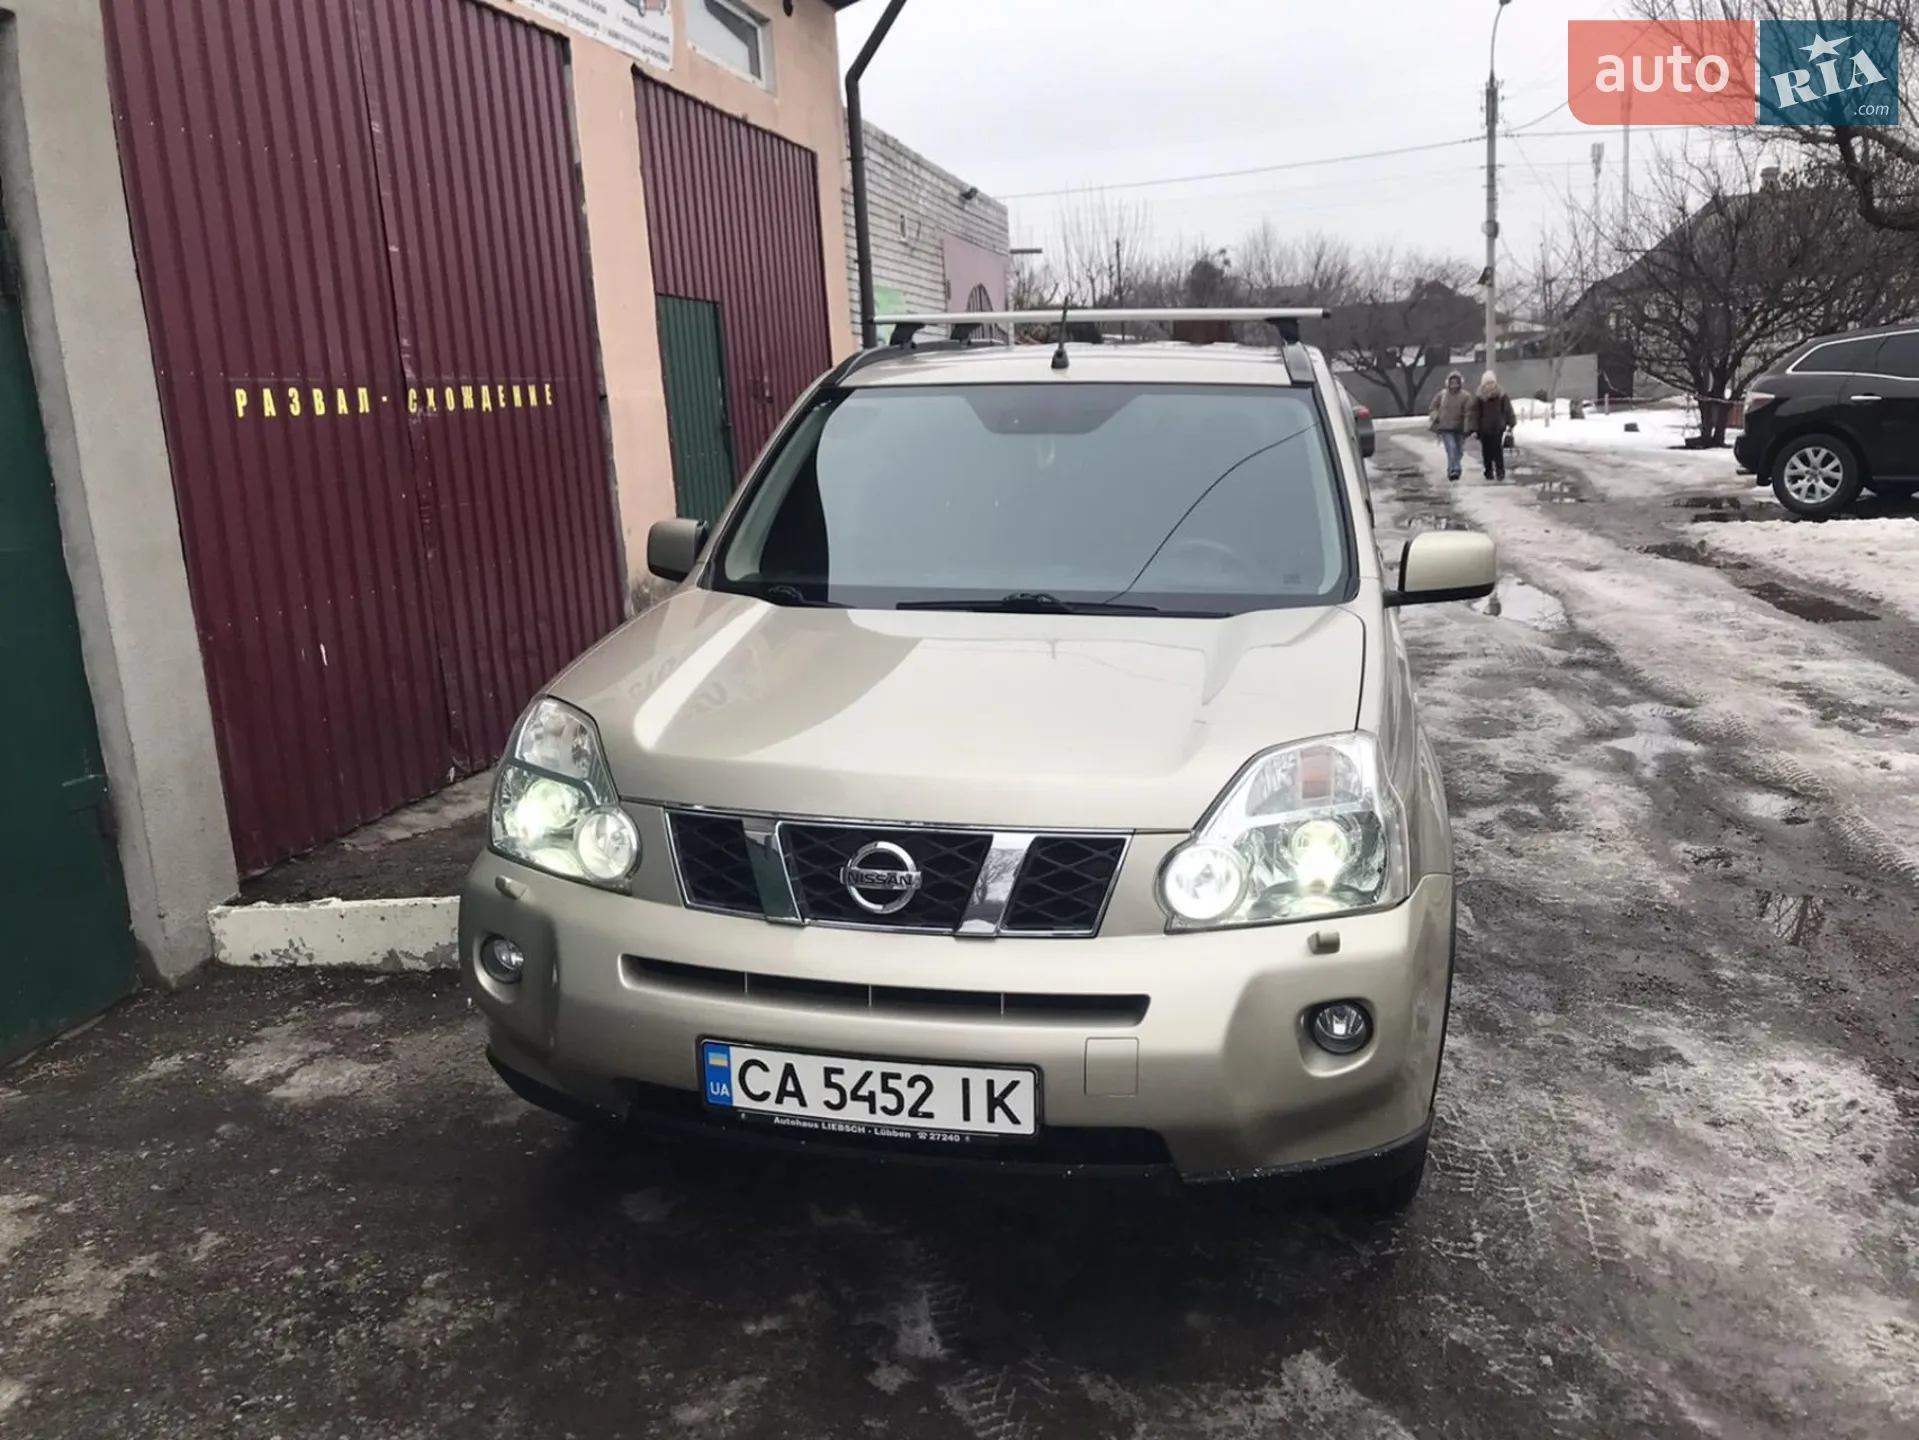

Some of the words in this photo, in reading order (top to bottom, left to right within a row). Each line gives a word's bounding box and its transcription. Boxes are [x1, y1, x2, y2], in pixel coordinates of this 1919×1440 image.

[847, 870, 914, 886] NISSAN
[710, 1081, 730, 1097] UA
[738, 1058, 808, 1108] CA
[822, 1066, 935, 1119] 5452
[961, 1077, 1022, 1126] IK
[773, 1116, 819, 1129] Autohaus
[821, 1121, 866, 1134] LIEBSCH
